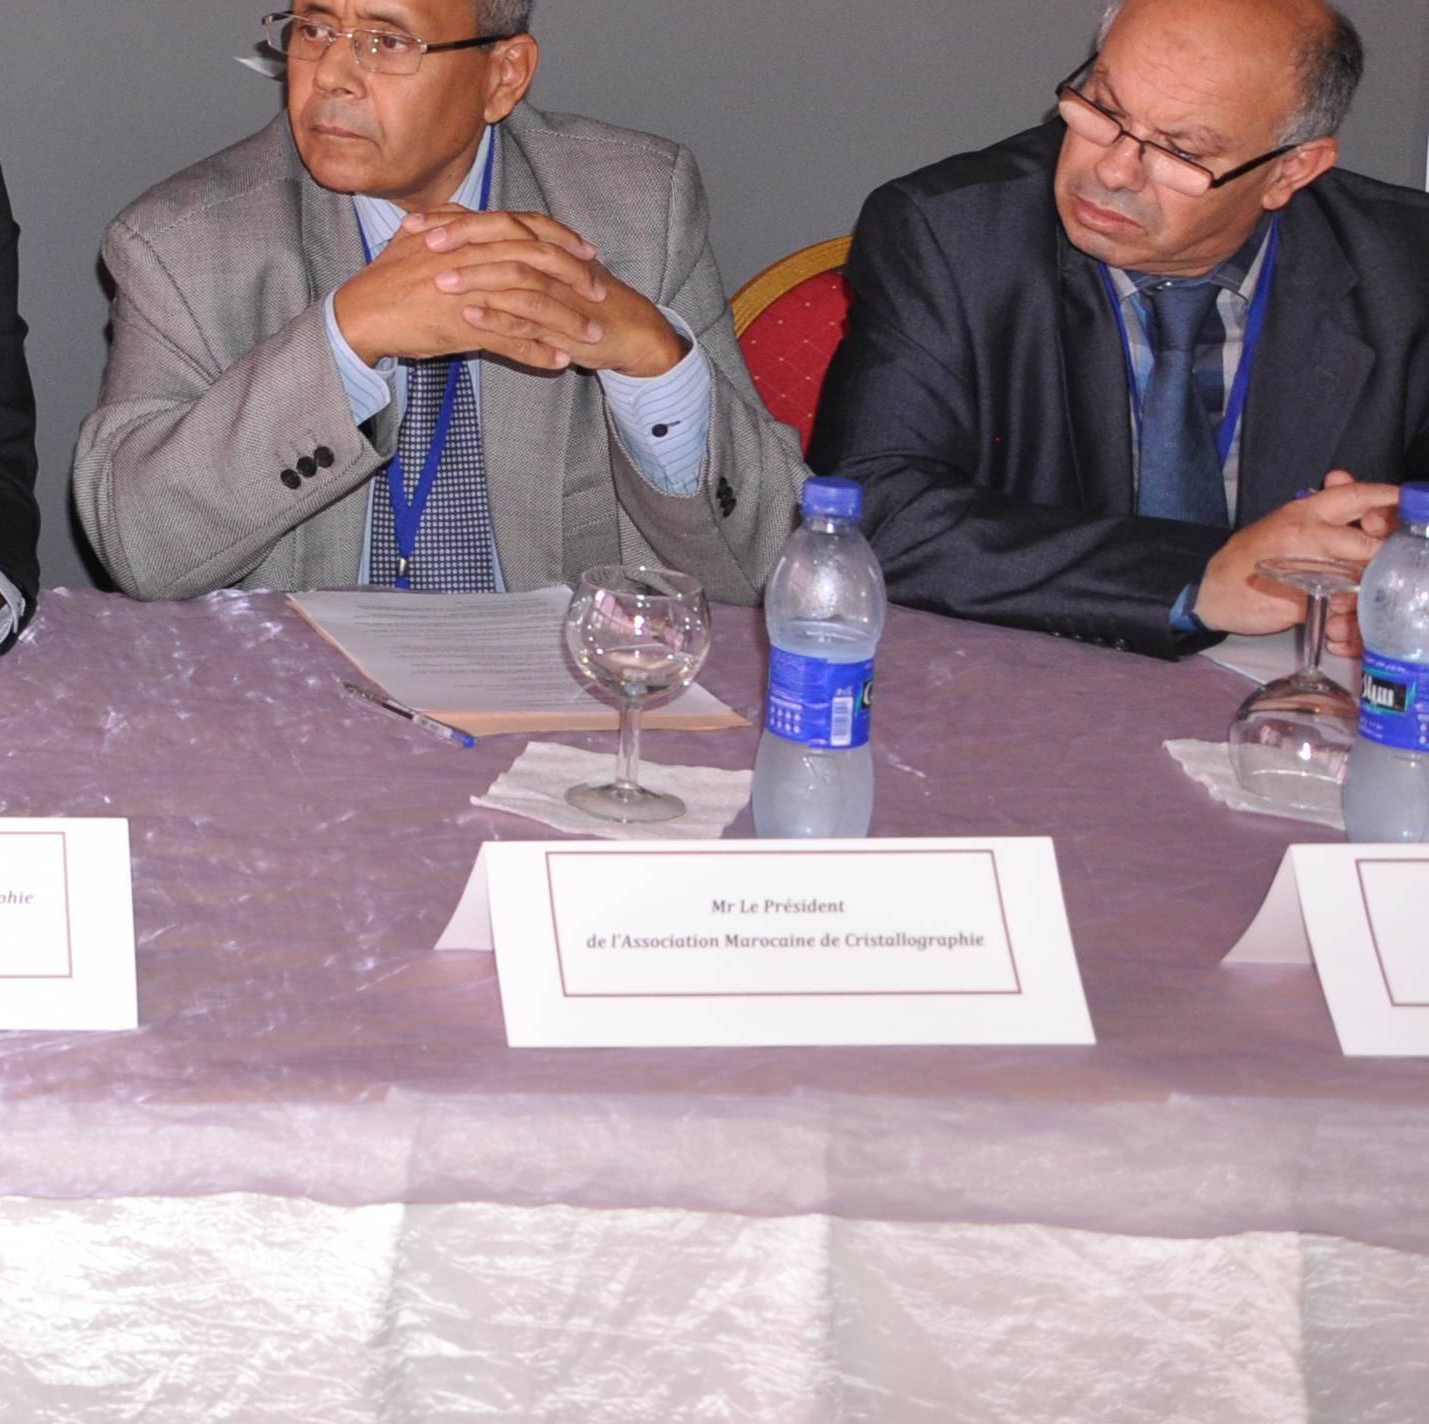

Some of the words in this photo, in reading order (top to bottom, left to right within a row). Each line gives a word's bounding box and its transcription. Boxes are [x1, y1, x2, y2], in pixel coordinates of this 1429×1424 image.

[711, 898, 736, 915] Mr
[739, 898, 760, 915] Le
[763, 896, 846, 915] Président
[586, 933, 608, 950] de
[611, 932, 720, 950] l'Association
[724, 932, 817, 949] Marocaine
[820, 932, 842, 949] de
[845, 931, 986, 954] Cristallographie
